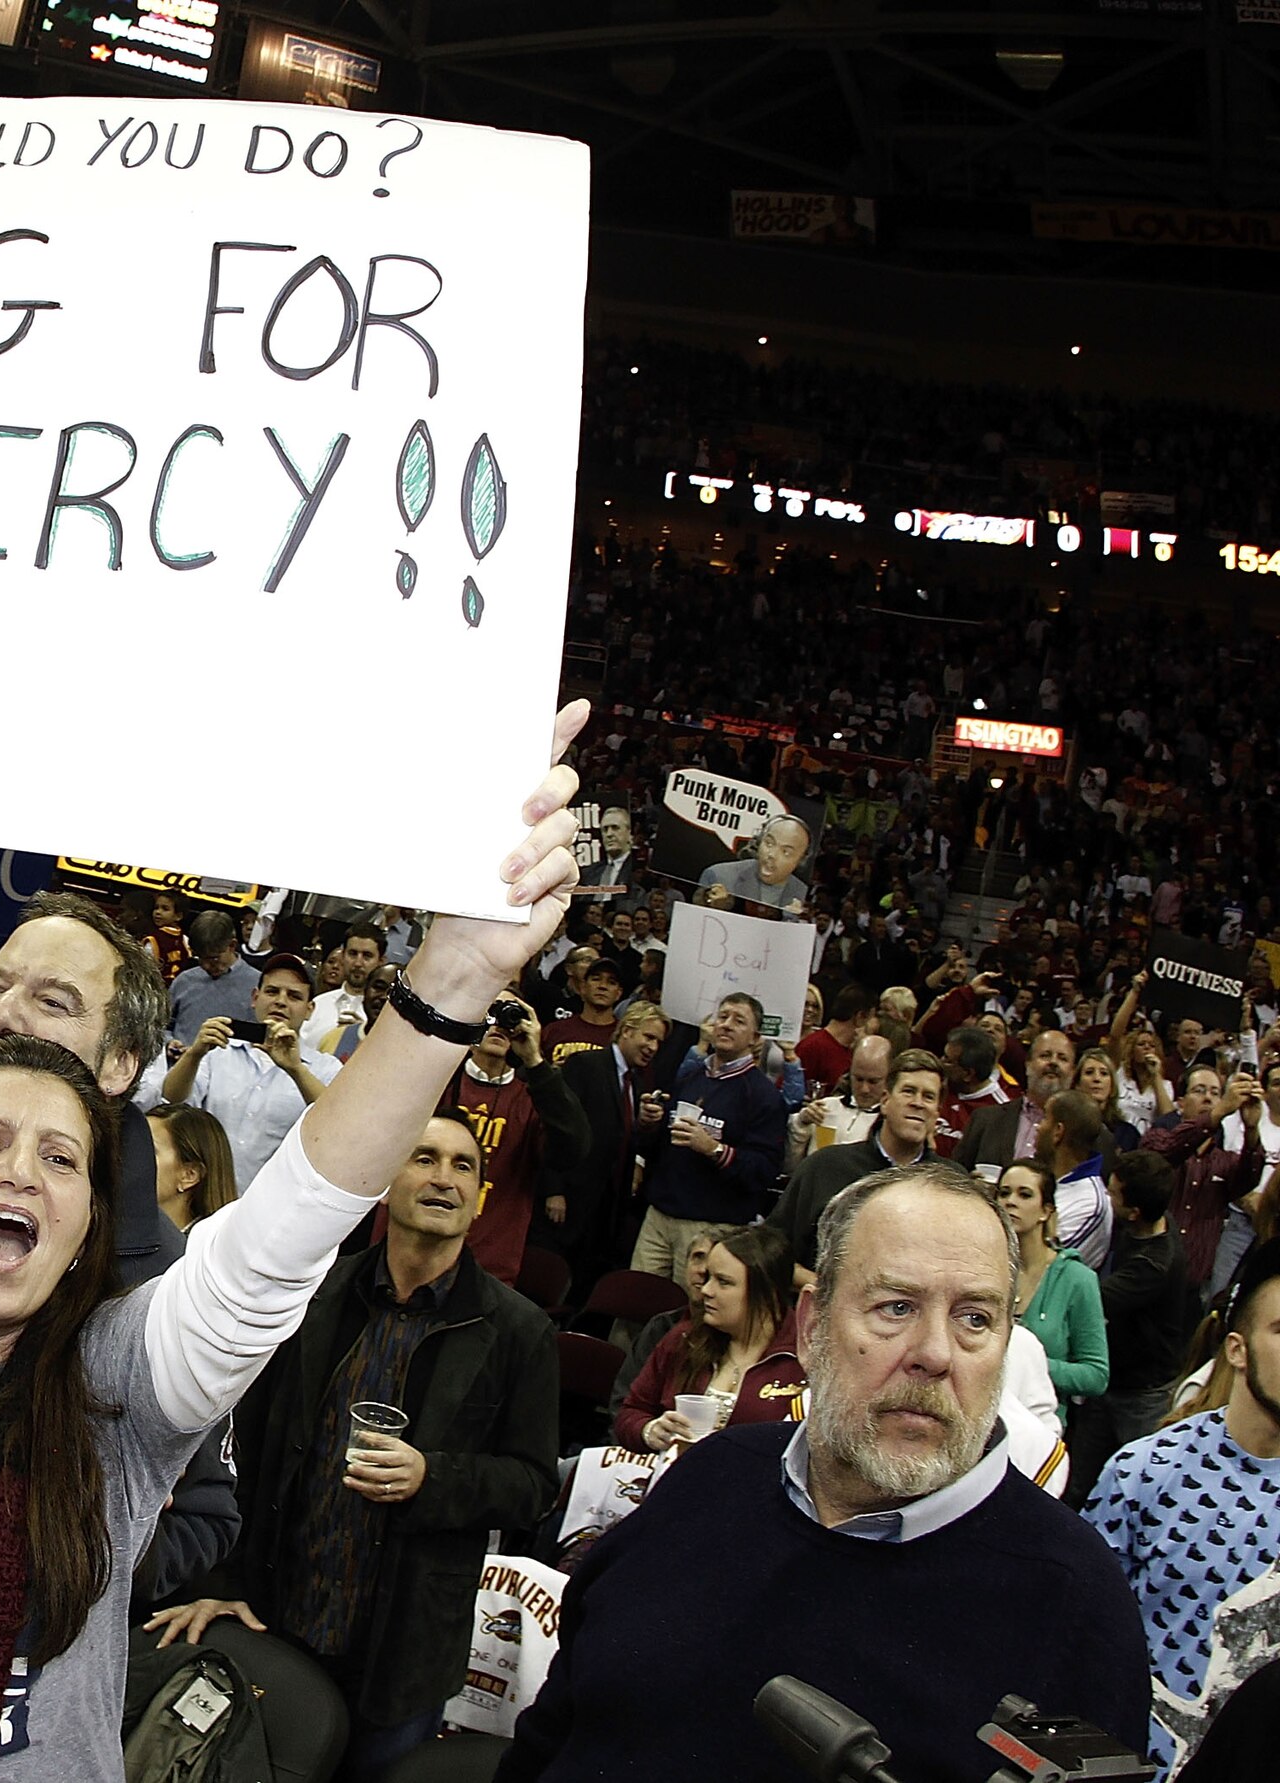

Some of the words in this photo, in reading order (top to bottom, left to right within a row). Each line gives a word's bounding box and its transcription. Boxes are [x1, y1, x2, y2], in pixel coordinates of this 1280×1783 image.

[87, 117, 205, 169] YOU
[199, 242, 443, 399] FOR
[956, 718, 1060, 751] TSINGTAO
[671, 773, 720, 802] Punk
[720, 786, 772, 818] Move,
[695, 800, 741, 830] 'Bron
[698, 915, 771, 971] Beat
[1153, 957, 1244, 998] QUITNESS
